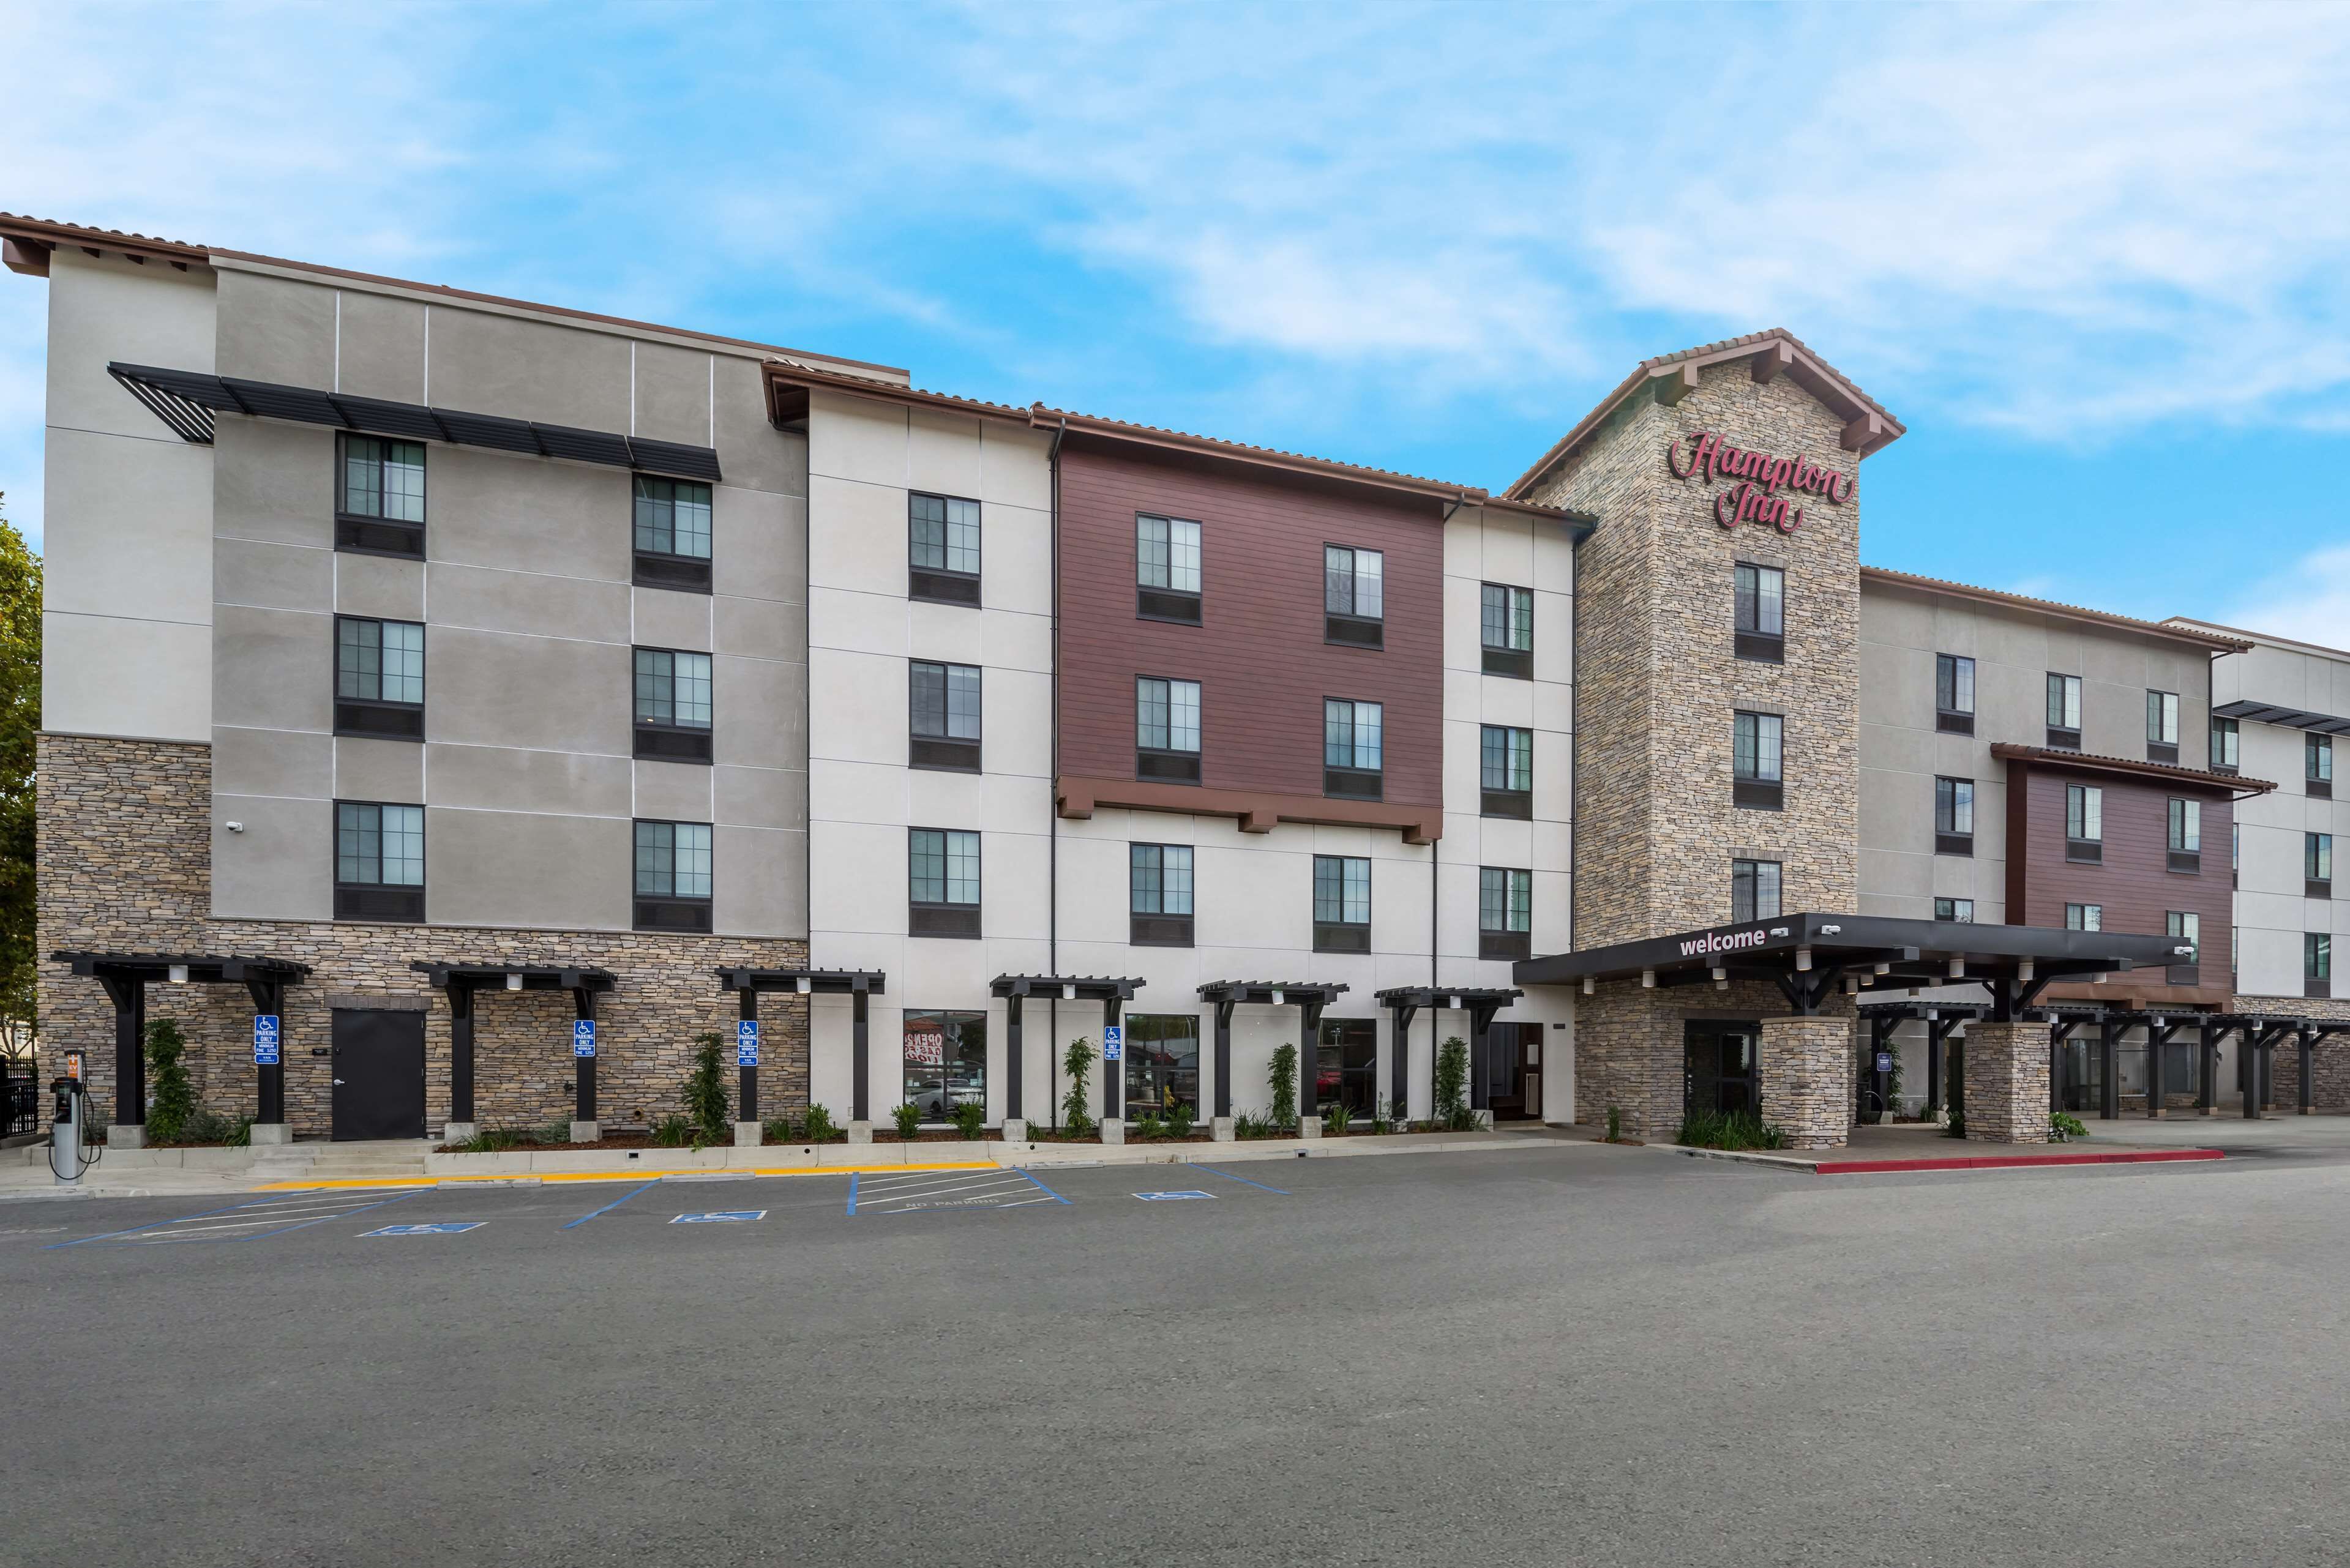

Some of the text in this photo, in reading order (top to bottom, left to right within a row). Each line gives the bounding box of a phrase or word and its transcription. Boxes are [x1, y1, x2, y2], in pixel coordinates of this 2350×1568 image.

[1670, 431, 1855, 504] Hampton
[1716, 482, 1803, 534] Inn
[1680, 930, 1766, 956] welcome
